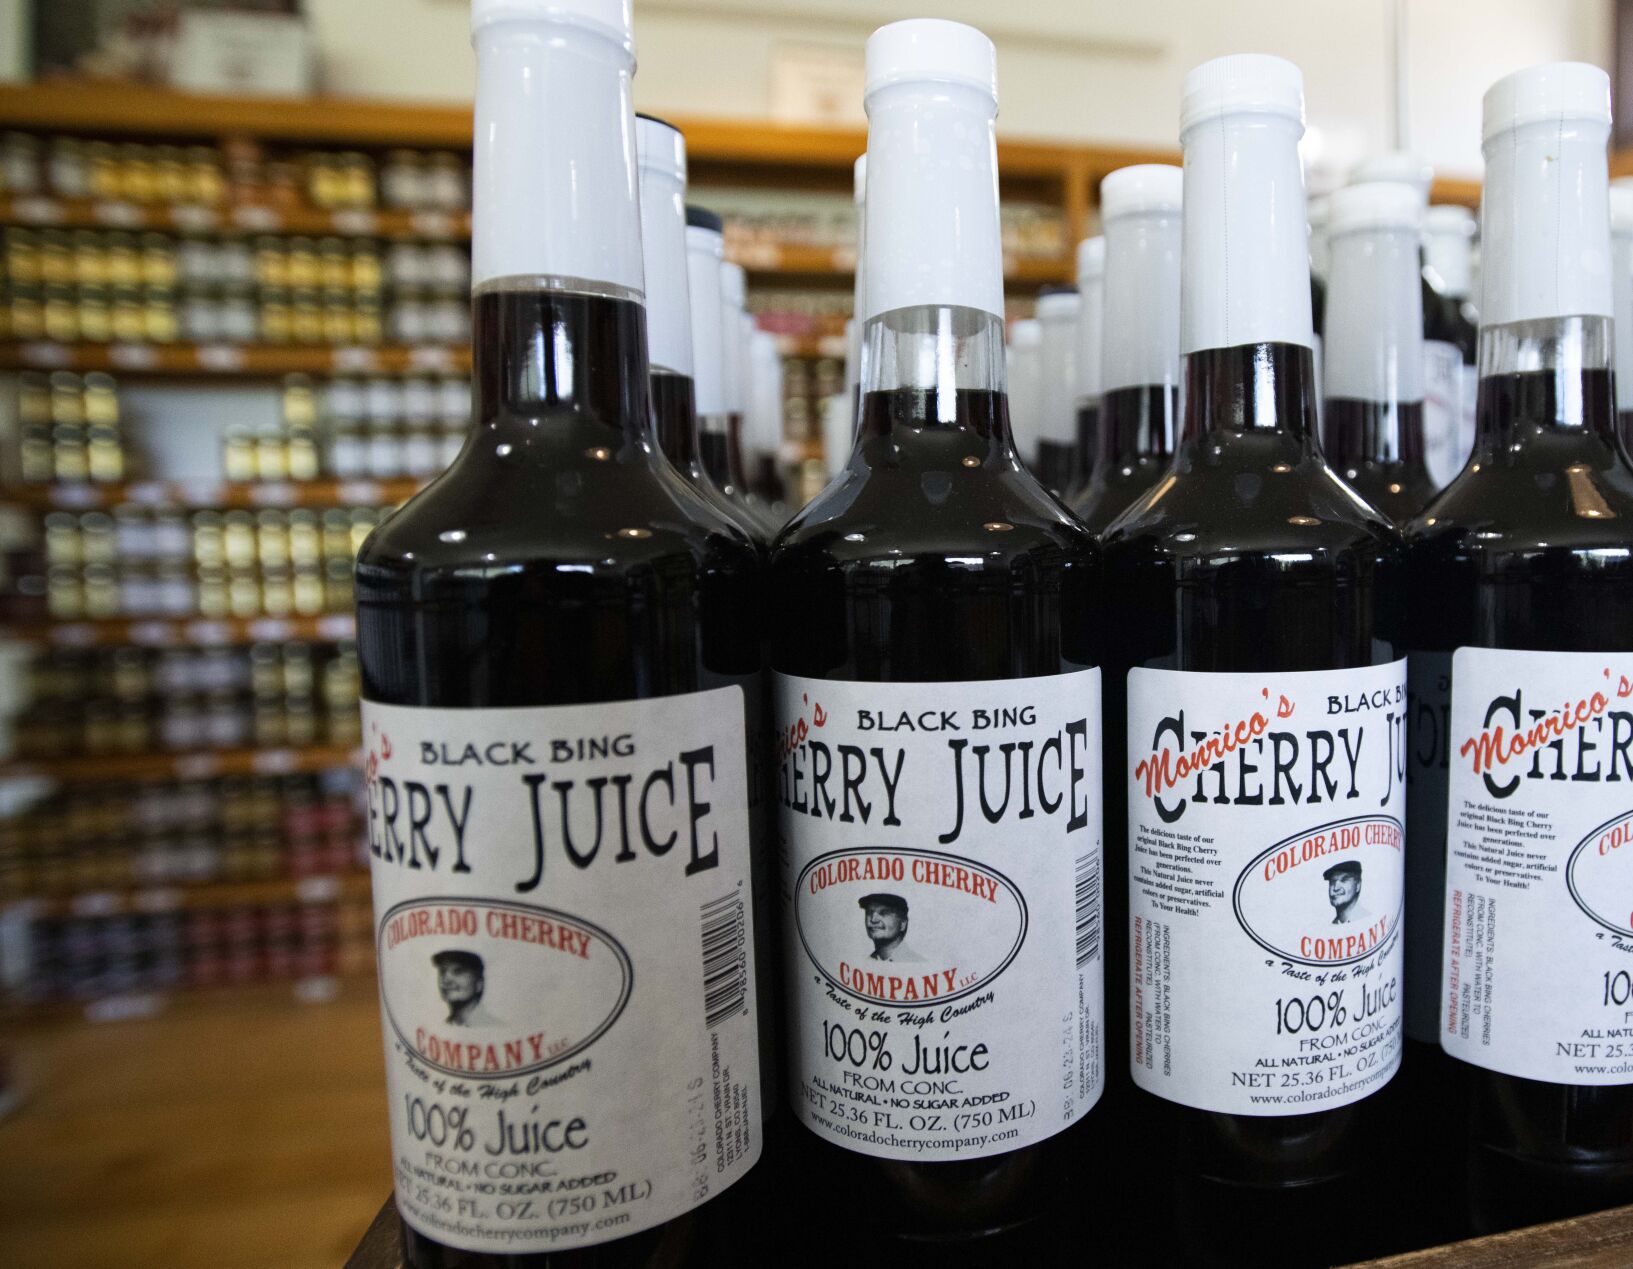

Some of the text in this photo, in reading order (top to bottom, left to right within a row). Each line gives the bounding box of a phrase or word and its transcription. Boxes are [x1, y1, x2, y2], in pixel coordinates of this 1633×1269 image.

[1327, 689, 1392, 715] BLACK
[857, 706, 1037, 731] BLACK BING
[420, 741, 536, 766] BLACK
[550, 734, 636, 764] BING
[1483, 688, 1633, 799] CHER
[938, 717, 1088, 844] JUICE
[1152, 709, 1363, 824] CHERRY
[515, 744, 719, 893] JUICE
[1464, 801, 1476, 809] The
[1478, 804, 1507, 814] delicious
[1140, 825, 1149, 833] The
[1151, 828, 1176, 839] delicious
[1177, 834, 1192, 842] taste
[1505, 830, 1538, 839] perfected
[1508, 818, 1524, 828] Bing
[1527, 821, 1553, 831] Cherry
[1159, 840, 1218, 856] Black Bing Cherry
[1160, 850, 1173, 860] been
[1175, 855, 1205, 864] perfected
[1265, 826, 1361, 881] COLORADO
[1479, 845, 1504, 855] Natural
[1483, 837, 1525, 848] generations.
[810, 857, 999, 904] COLORADO CHERRY
[1153, 870, 1176, 881] Natural
[1156, 862, 1193, 873] generations.
[1495, 869, 1544, 881] preservatives.
[1503, 860, 1525, 869] sugar,
[1526, 863, 1557, 872] artificial
[1155, 882, 1224, 898] added sugar, artificial
[1504, 880, 1530, 890] Health!
[1152, 900, 1199, 917] To Your Health!
[1167, 895, 1211, 907] preservatives.
[387, 909, 593, 960] COLORADO CHERRY
[737, 902, 748, 996] 98560 00206
[1154, 922, 1162, 950] (FROM
[1301, 915, 1387, 960] COMPANY
[1135, 916, 1143, 984] REFRIGERATE
[1449, 890, 1462, 1035] REFRIGERATE AFTER OPENING
[1473, 895, 1485, 1016] (FROM CONC. WITH WATER TO
[840, 962, 978, 1000] COMPANY LLC
[1281, 962, 1312, 982] Taste
[1316, 972, 1328, 987] of
[1331, 970, 1348, 983] the
[1352, 960, 1375, 980] High
[1486, 956, 1494, 982] BLACK
[825, 983, 995, 1030] Taste of the High Country
[1135, 987, 1143, 1019] AFTER
[1275, 973, 1397, 1035] 100% Juice
[1155, 1033, 1162, 1045] TO
[1483, 1005, 1492, 1047] CHERRIES
[1581, 1029, 1605, 1039] ALL
[416, 1027, 545, 1072] COMPANY
[823, 1020, 990, 1075] 100% Juice
[1255, 1033, 1385, 1068] ALL NATURAL NO SUGAR
[1300, 1033, 1348, 1052] FROM
[1556, 1043, 1601, 1058] NET
[526, 1058, 592, 1096] Country
[843, 1071, 964, 1095] FROM CONC.
[1232, 1052, 1379, 1088] NET 25.36 FL. OZ.
[801, 1081, 1037, 1133] NET 25.36 FL. OZ. (750 ML)
[812, 1075, 1011, 1110] ALL NATURAL NO SUGAR ADDED
[405, 1093, 589, 1156] 100% Juice
[811, 1111, 1019, 1151] www.coloradocherrycompany.com
[425, 1152, 558, 1179] FROM CONC.
[474, 1172, 617, 1196] NO SUGAR ADDED
[496, 1202, 539, 1220] OZ.
[548, 1195, 596, 1221] (750
[603, 1179, 652, 1209] ML)
